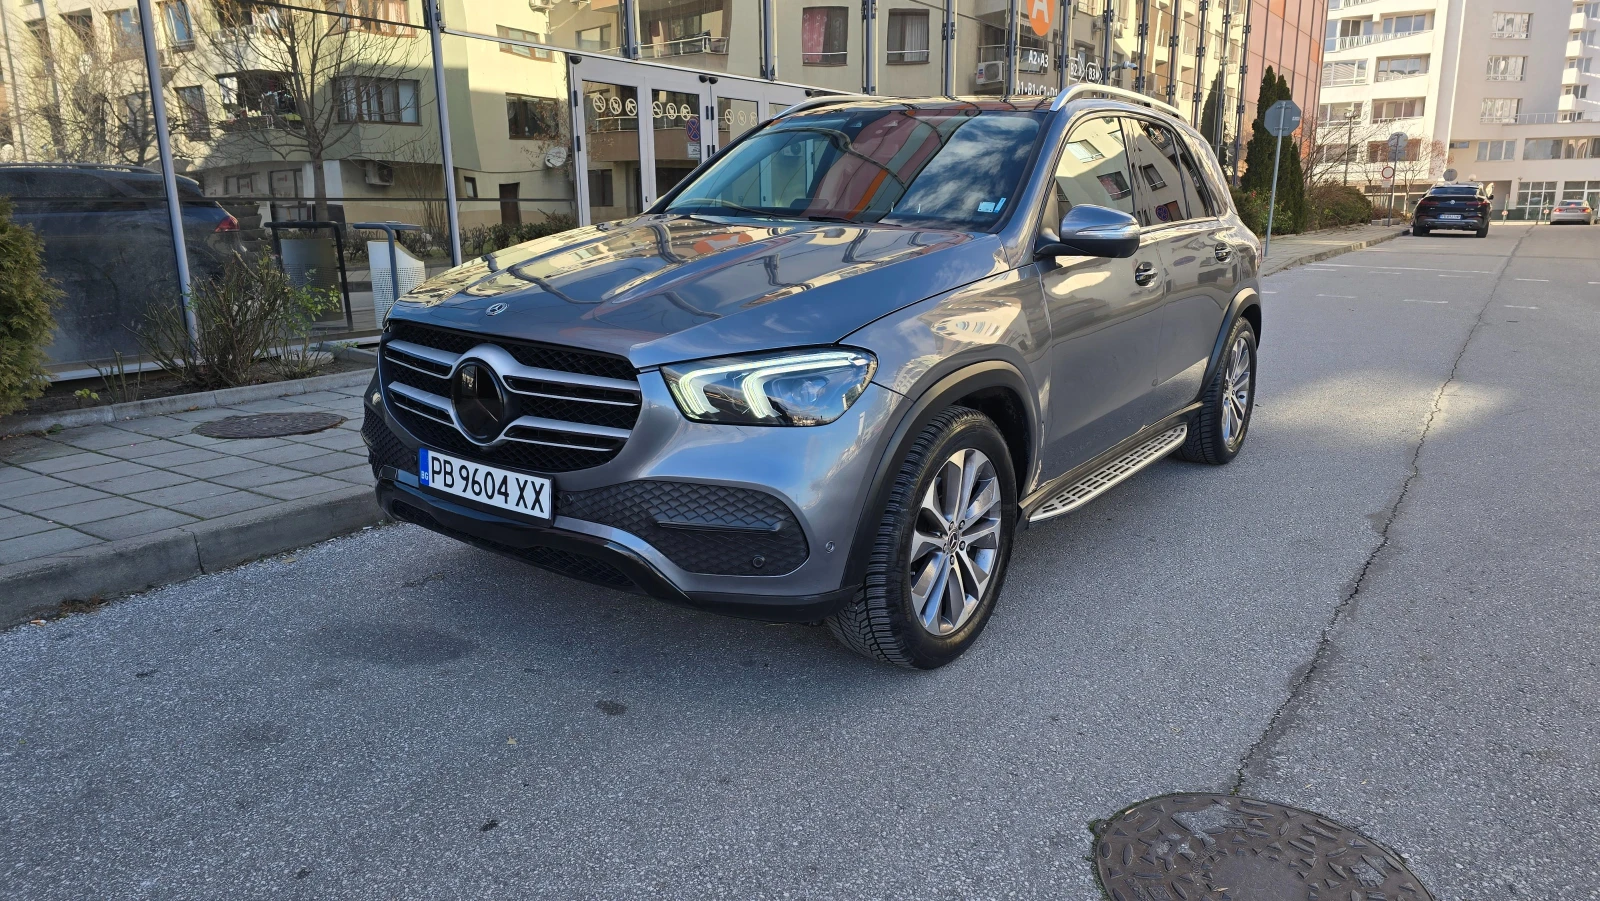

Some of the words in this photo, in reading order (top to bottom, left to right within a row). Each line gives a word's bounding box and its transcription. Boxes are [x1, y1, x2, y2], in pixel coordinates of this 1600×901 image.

[1032, 0, 1049, 24] A
[1088, 67, 1096, 81] B3
[431, 456, 455, 489] PB
[458, 464, 509, 505] 9604
[515, 477, 545, 514] XX
